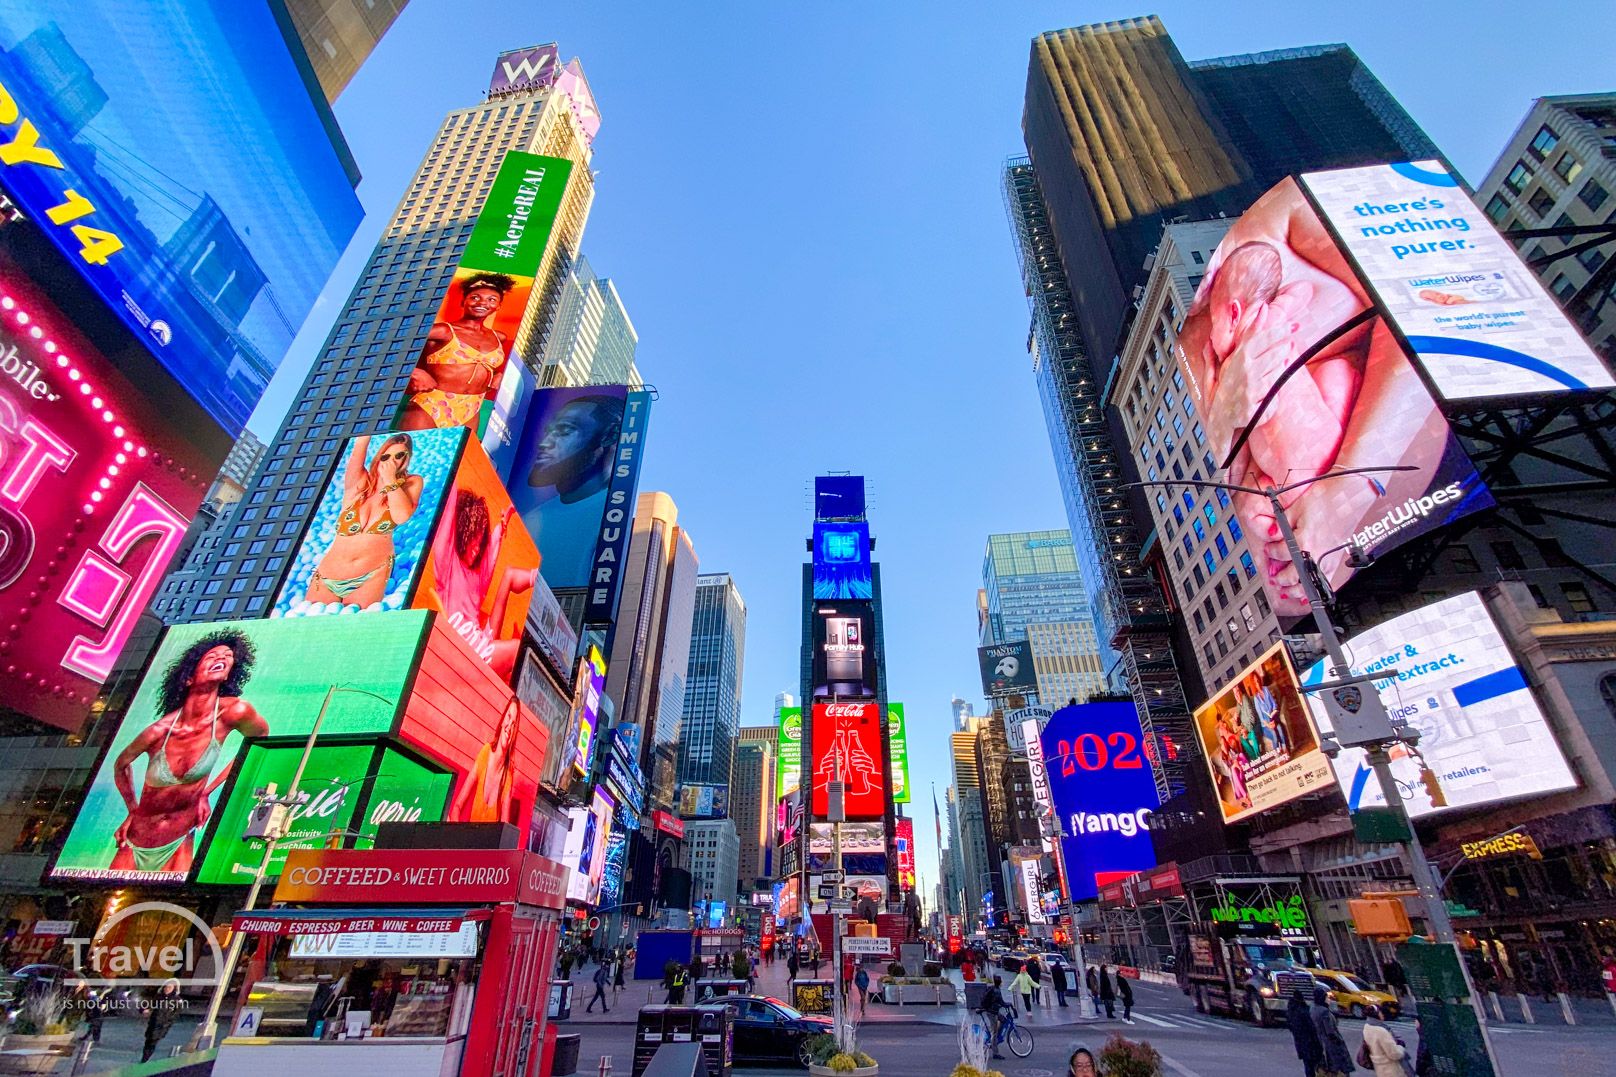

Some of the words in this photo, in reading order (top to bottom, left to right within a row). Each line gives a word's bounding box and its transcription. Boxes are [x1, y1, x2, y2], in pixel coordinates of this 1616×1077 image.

[502, 54, 550, 84] W
[494, 166, 546, 259] #AerieREAL
[1353, 196, 1445, 218] there's
[45, 188, 124, 266] 14
[1361, 216, 1471, 238] nothing
[1390, 238, 1476, 260] purer.
[1409, 274, 1486, 287] WaterWipes
[616, 400, 642, 478] TIMES
[593, 490, 626, 605] SQUARE
[986, 646, 1022, 656] PHANTOM
[1364, 650, 1401, 674] water
[1404, 644, 1419, 658] &
[1397, 652, 1465, 683] extract.
[1008, 708, 1033, 724] LITTLE
[1443, 765, 1491, 781] retailers.
[281, 830, 322, 838] ositivity
[1460, 832, 1526, 859] EXPRESS
[54, 868, 98, 879] AMERICAN
[100, 869, 129, 880] EAGLE
[288, 867, 392, 886] COFFEED
[394, 873, 401, 882] &
[402, 867, 445, 887] SWEET
[450, 867, 511, 887] CHURROS
[529, 869, 562, 897] COFFEED
[240, 919, 283, 933] CHURRO
[289, 921, 341, 933] ESPRESSO
[348, 920, 375, 931] BEER
[382, 920, 408, 931] WINE
[416, 920, 453, 931] COFFEE
[243, 1012, 254, 1028] A
